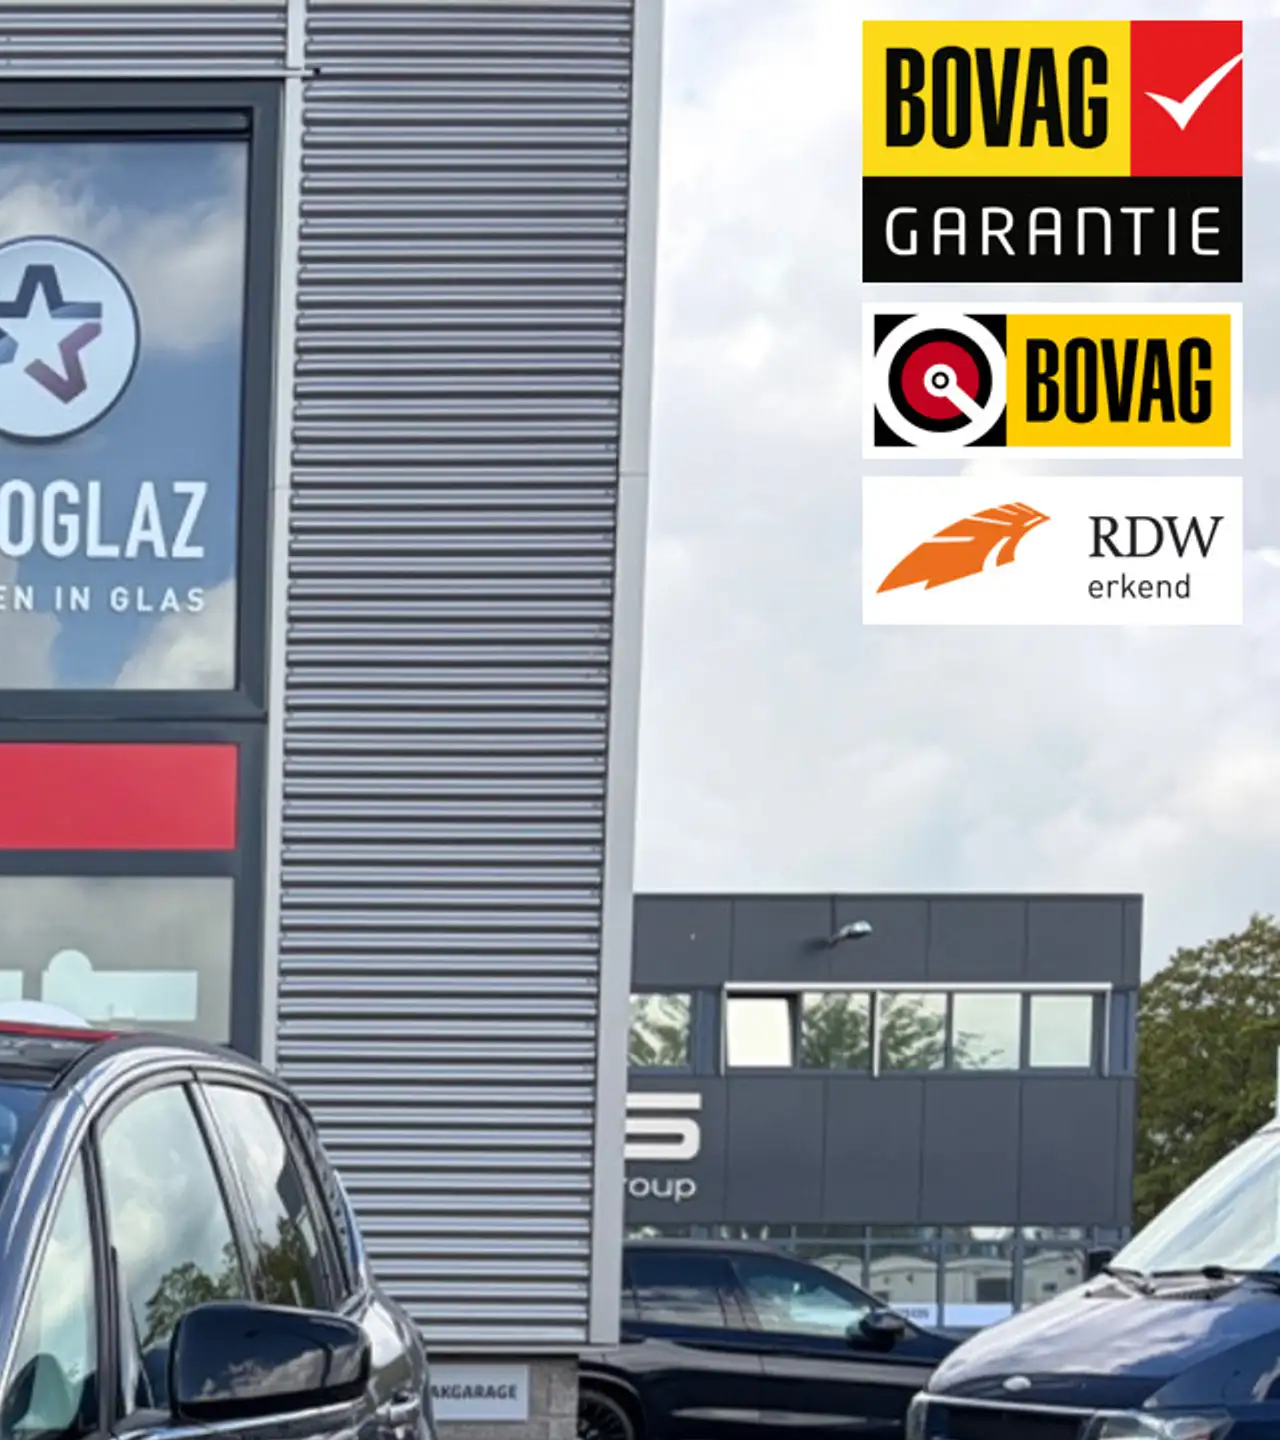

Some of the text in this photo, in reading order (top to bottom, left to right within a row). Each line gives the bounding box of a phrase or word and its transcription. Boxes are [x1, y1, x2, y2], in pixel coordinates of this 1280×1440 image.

[55, 585, 90, 612] IN
[110, 585, 205, 613] GLAS
[430, 1383, 518, 1400] AKGARAGE
